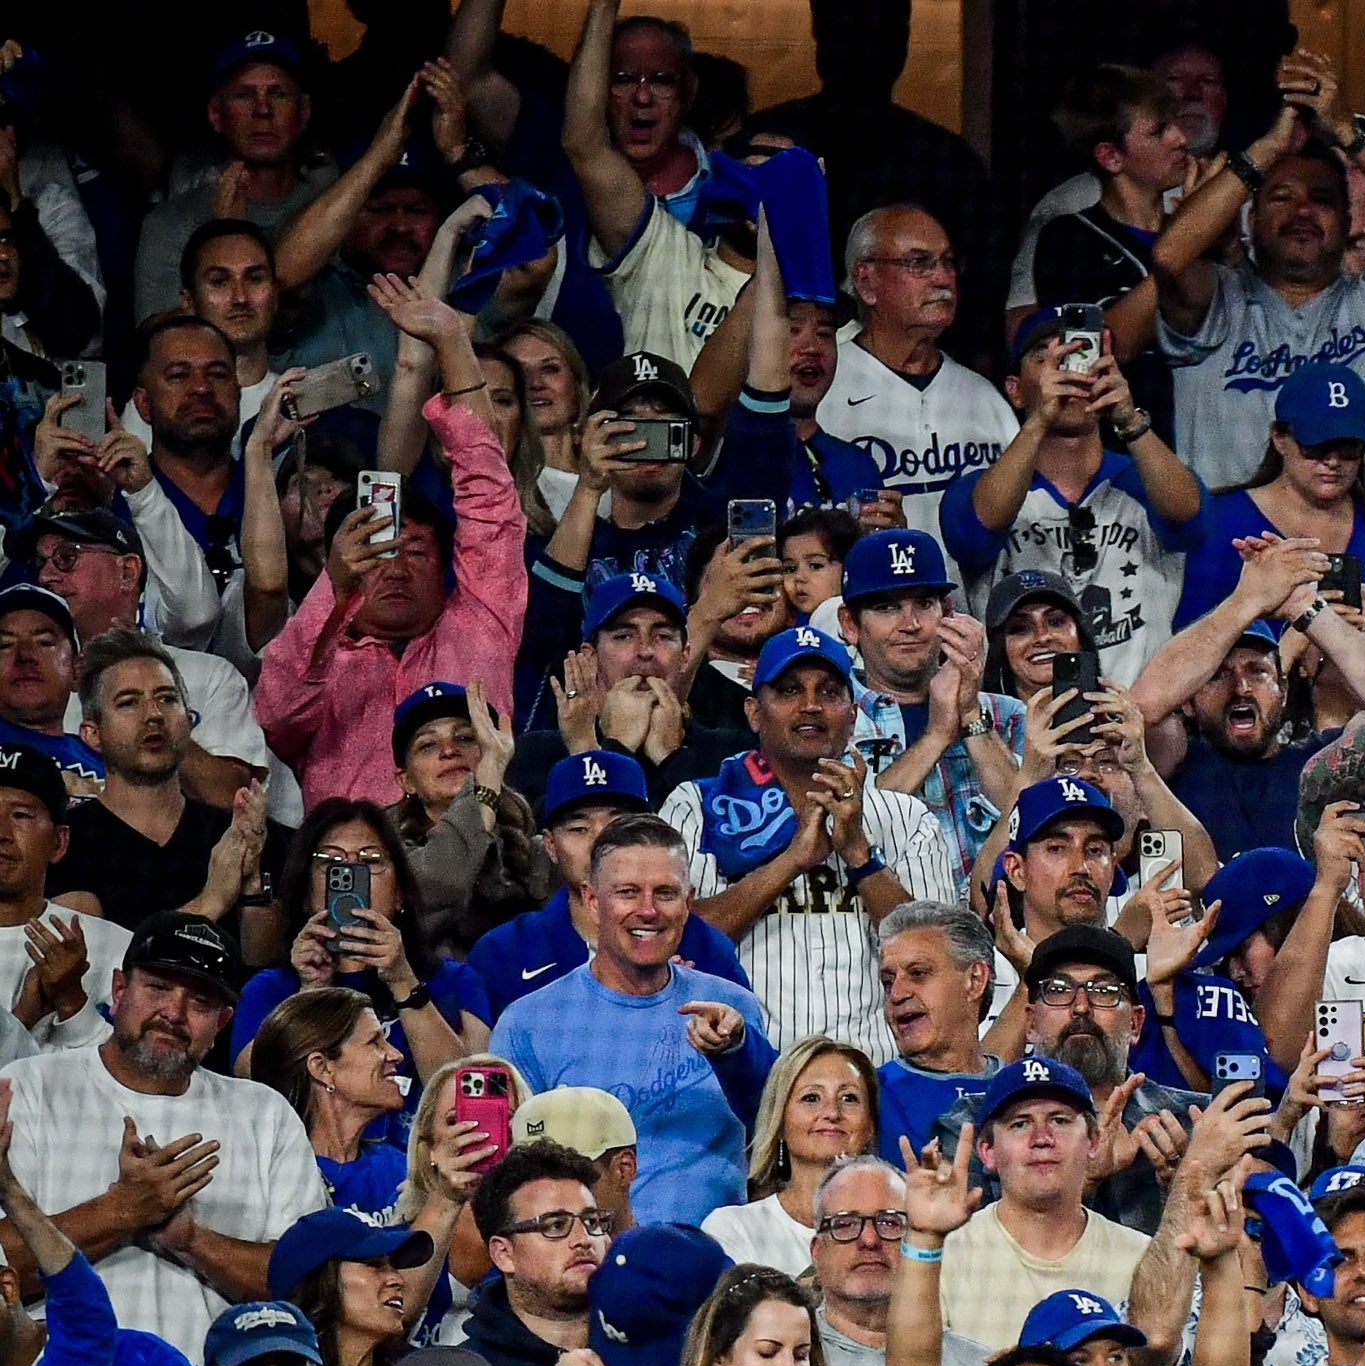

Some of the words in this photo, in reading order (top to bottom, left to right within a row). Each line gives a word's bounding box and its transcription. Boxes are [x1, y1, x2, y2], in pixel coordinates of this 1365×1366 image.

[633, 353, 659, 380] LA
[1226, 340, 1270, 382] Los
[1329, 382, 1349, 408] B
[888, 542, 916, 574] LA
[631, 573, 658, 592] LA
[797, 629, 820, 648] LA
[582, 757, 608, 785] LA
[1060, 780, 1088, 802] LA
[606, 1052, 711, 1112] Dodgers
[1024, 1060, 1049, 1081] LA
[1327, 1171, 1363, 1192] 17
[1070, 1294, 1104, 1315] LA
